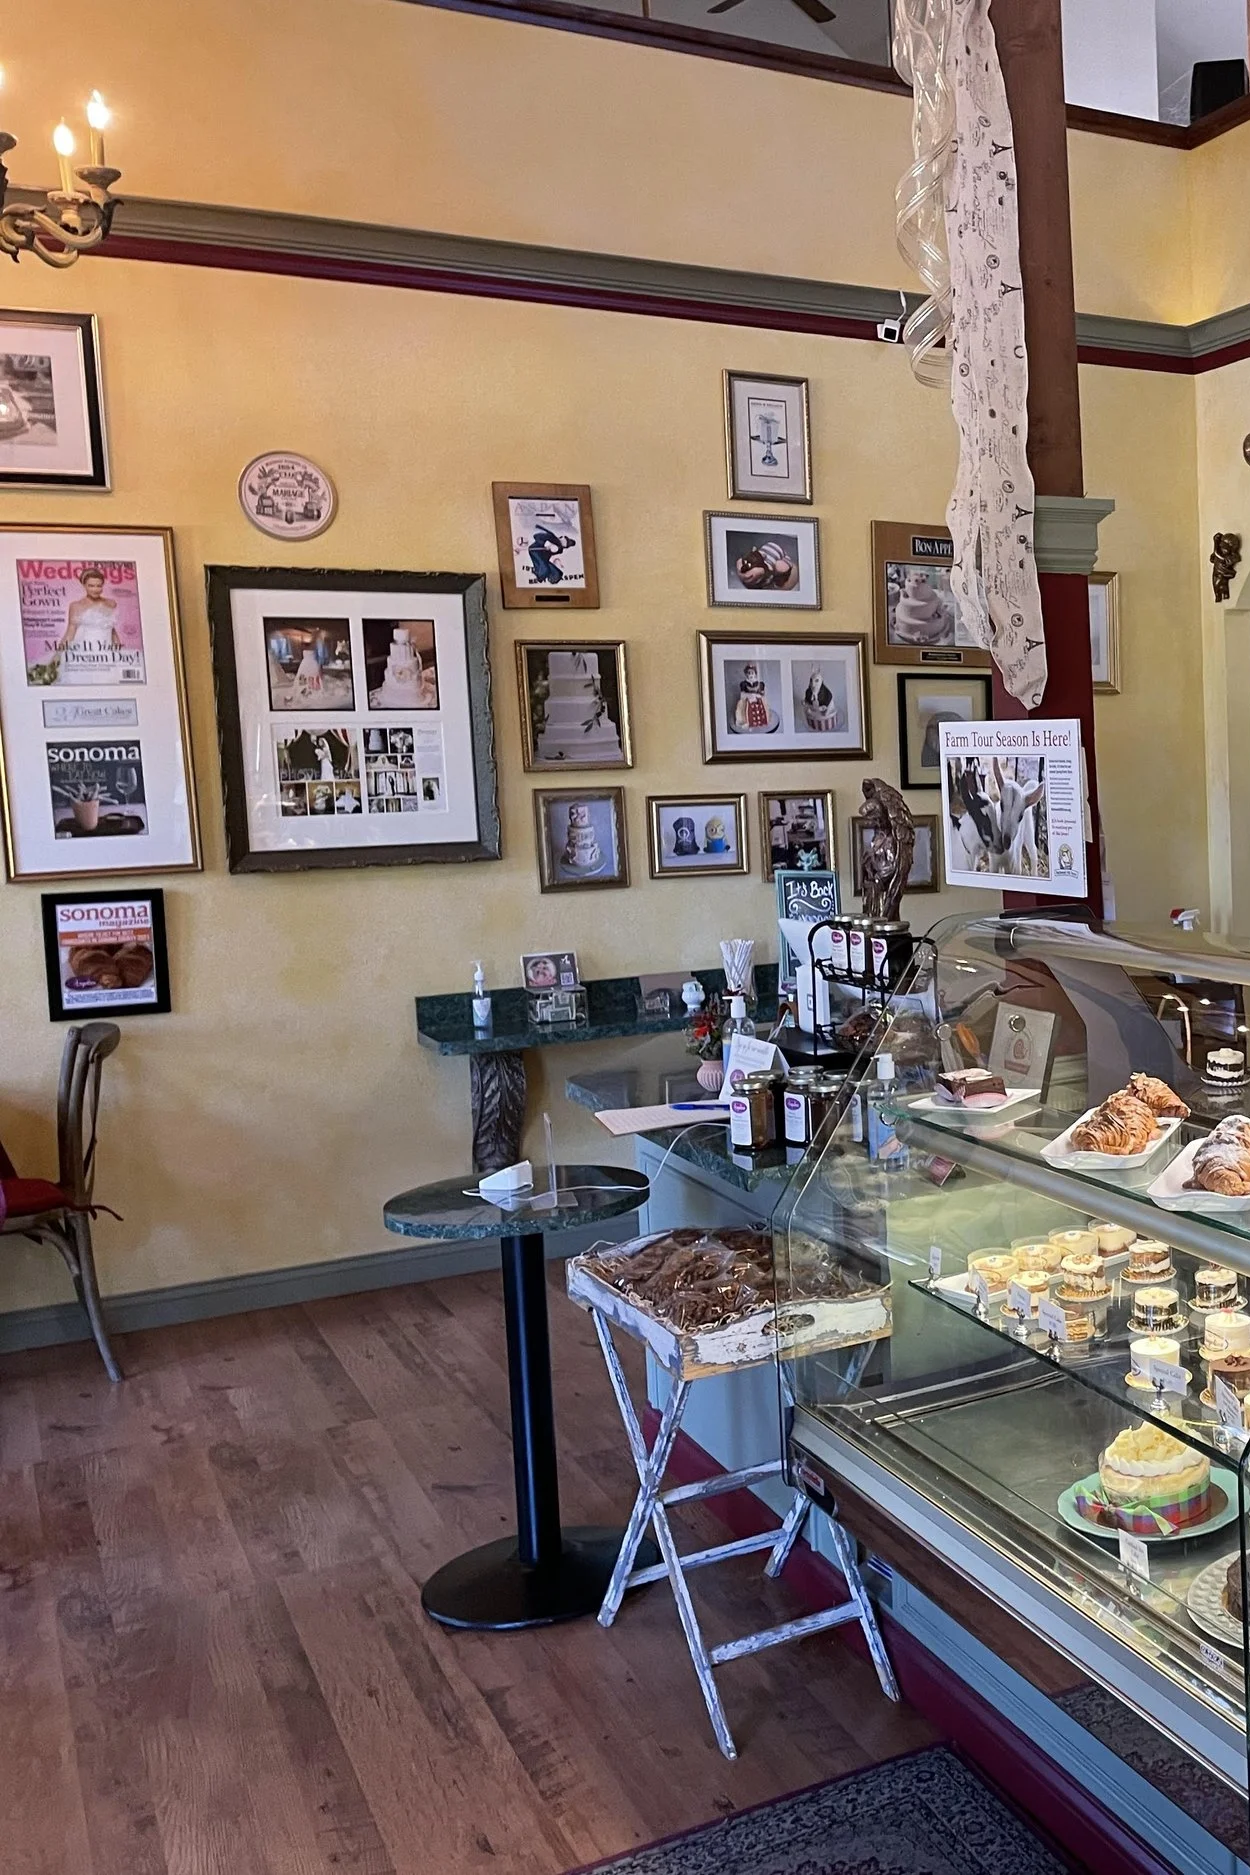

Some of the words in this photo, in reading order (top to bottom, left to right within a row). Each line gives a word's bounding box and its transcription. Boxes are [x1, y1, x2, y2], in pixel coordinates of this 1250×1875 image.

[915, 539, 932, 553] BON
[44, 639, 80, 652] Make
[83, 640, 93, 651] It
[97, 640, 125, 651] Your
[65, 651, 109, 663] Dream
[112, 651, 140, 665] Day!
[945, 731, 969, 748] Farm
[971, 731, 993, 747] Tour
[995, 730, 1029, 747] Season
[1032, 730, 1040, 746] Is
[1043, 730, 1071, 747] Here!
[48, 745, 140, 763] sonoma
[810, 880, 834, 899] Back
[60, 904, 148, 922] sonoma
